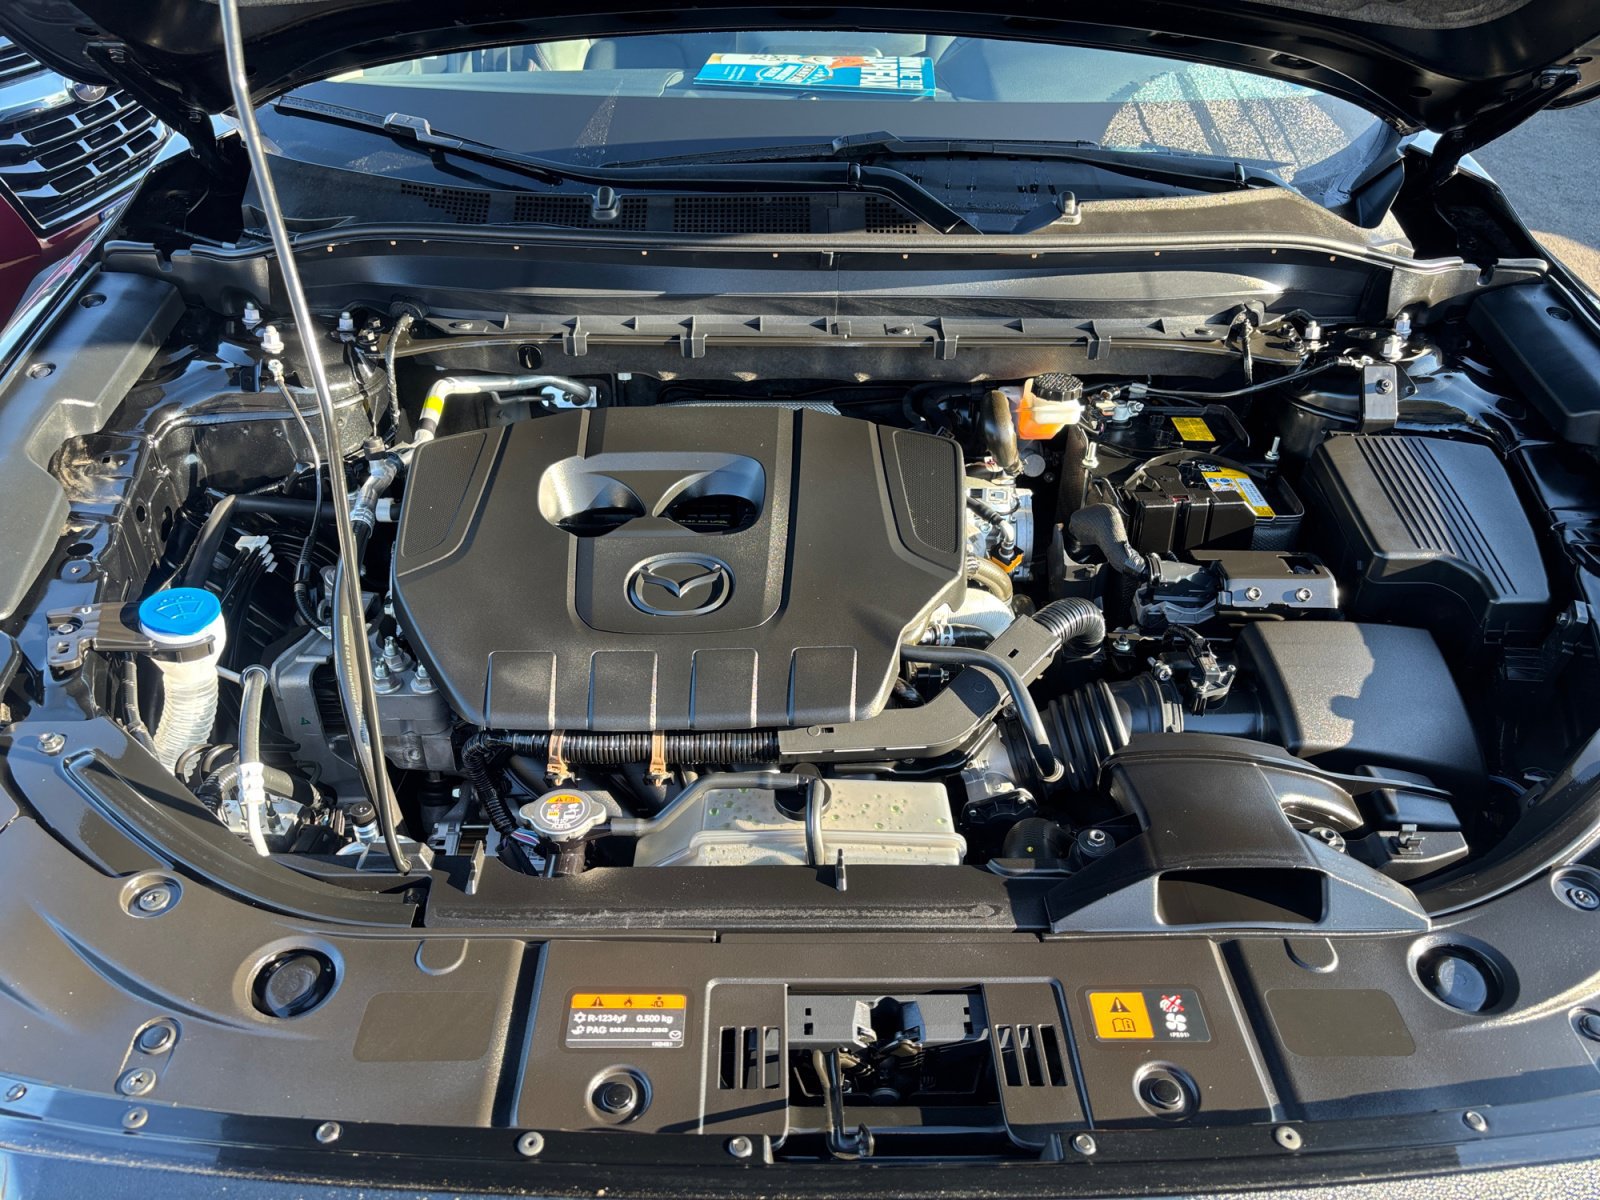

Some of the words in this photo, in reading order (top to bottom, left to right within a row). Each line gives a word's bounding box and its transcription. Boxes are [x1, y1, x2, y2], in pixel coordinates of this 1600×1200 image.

[587, 1014, 627, 1024] R-1234yf
[636, 1014, 660, 1023] 0.500
[661, 1014, 674, 1024] kg
[586, 1026, 608, 1034] PAG
